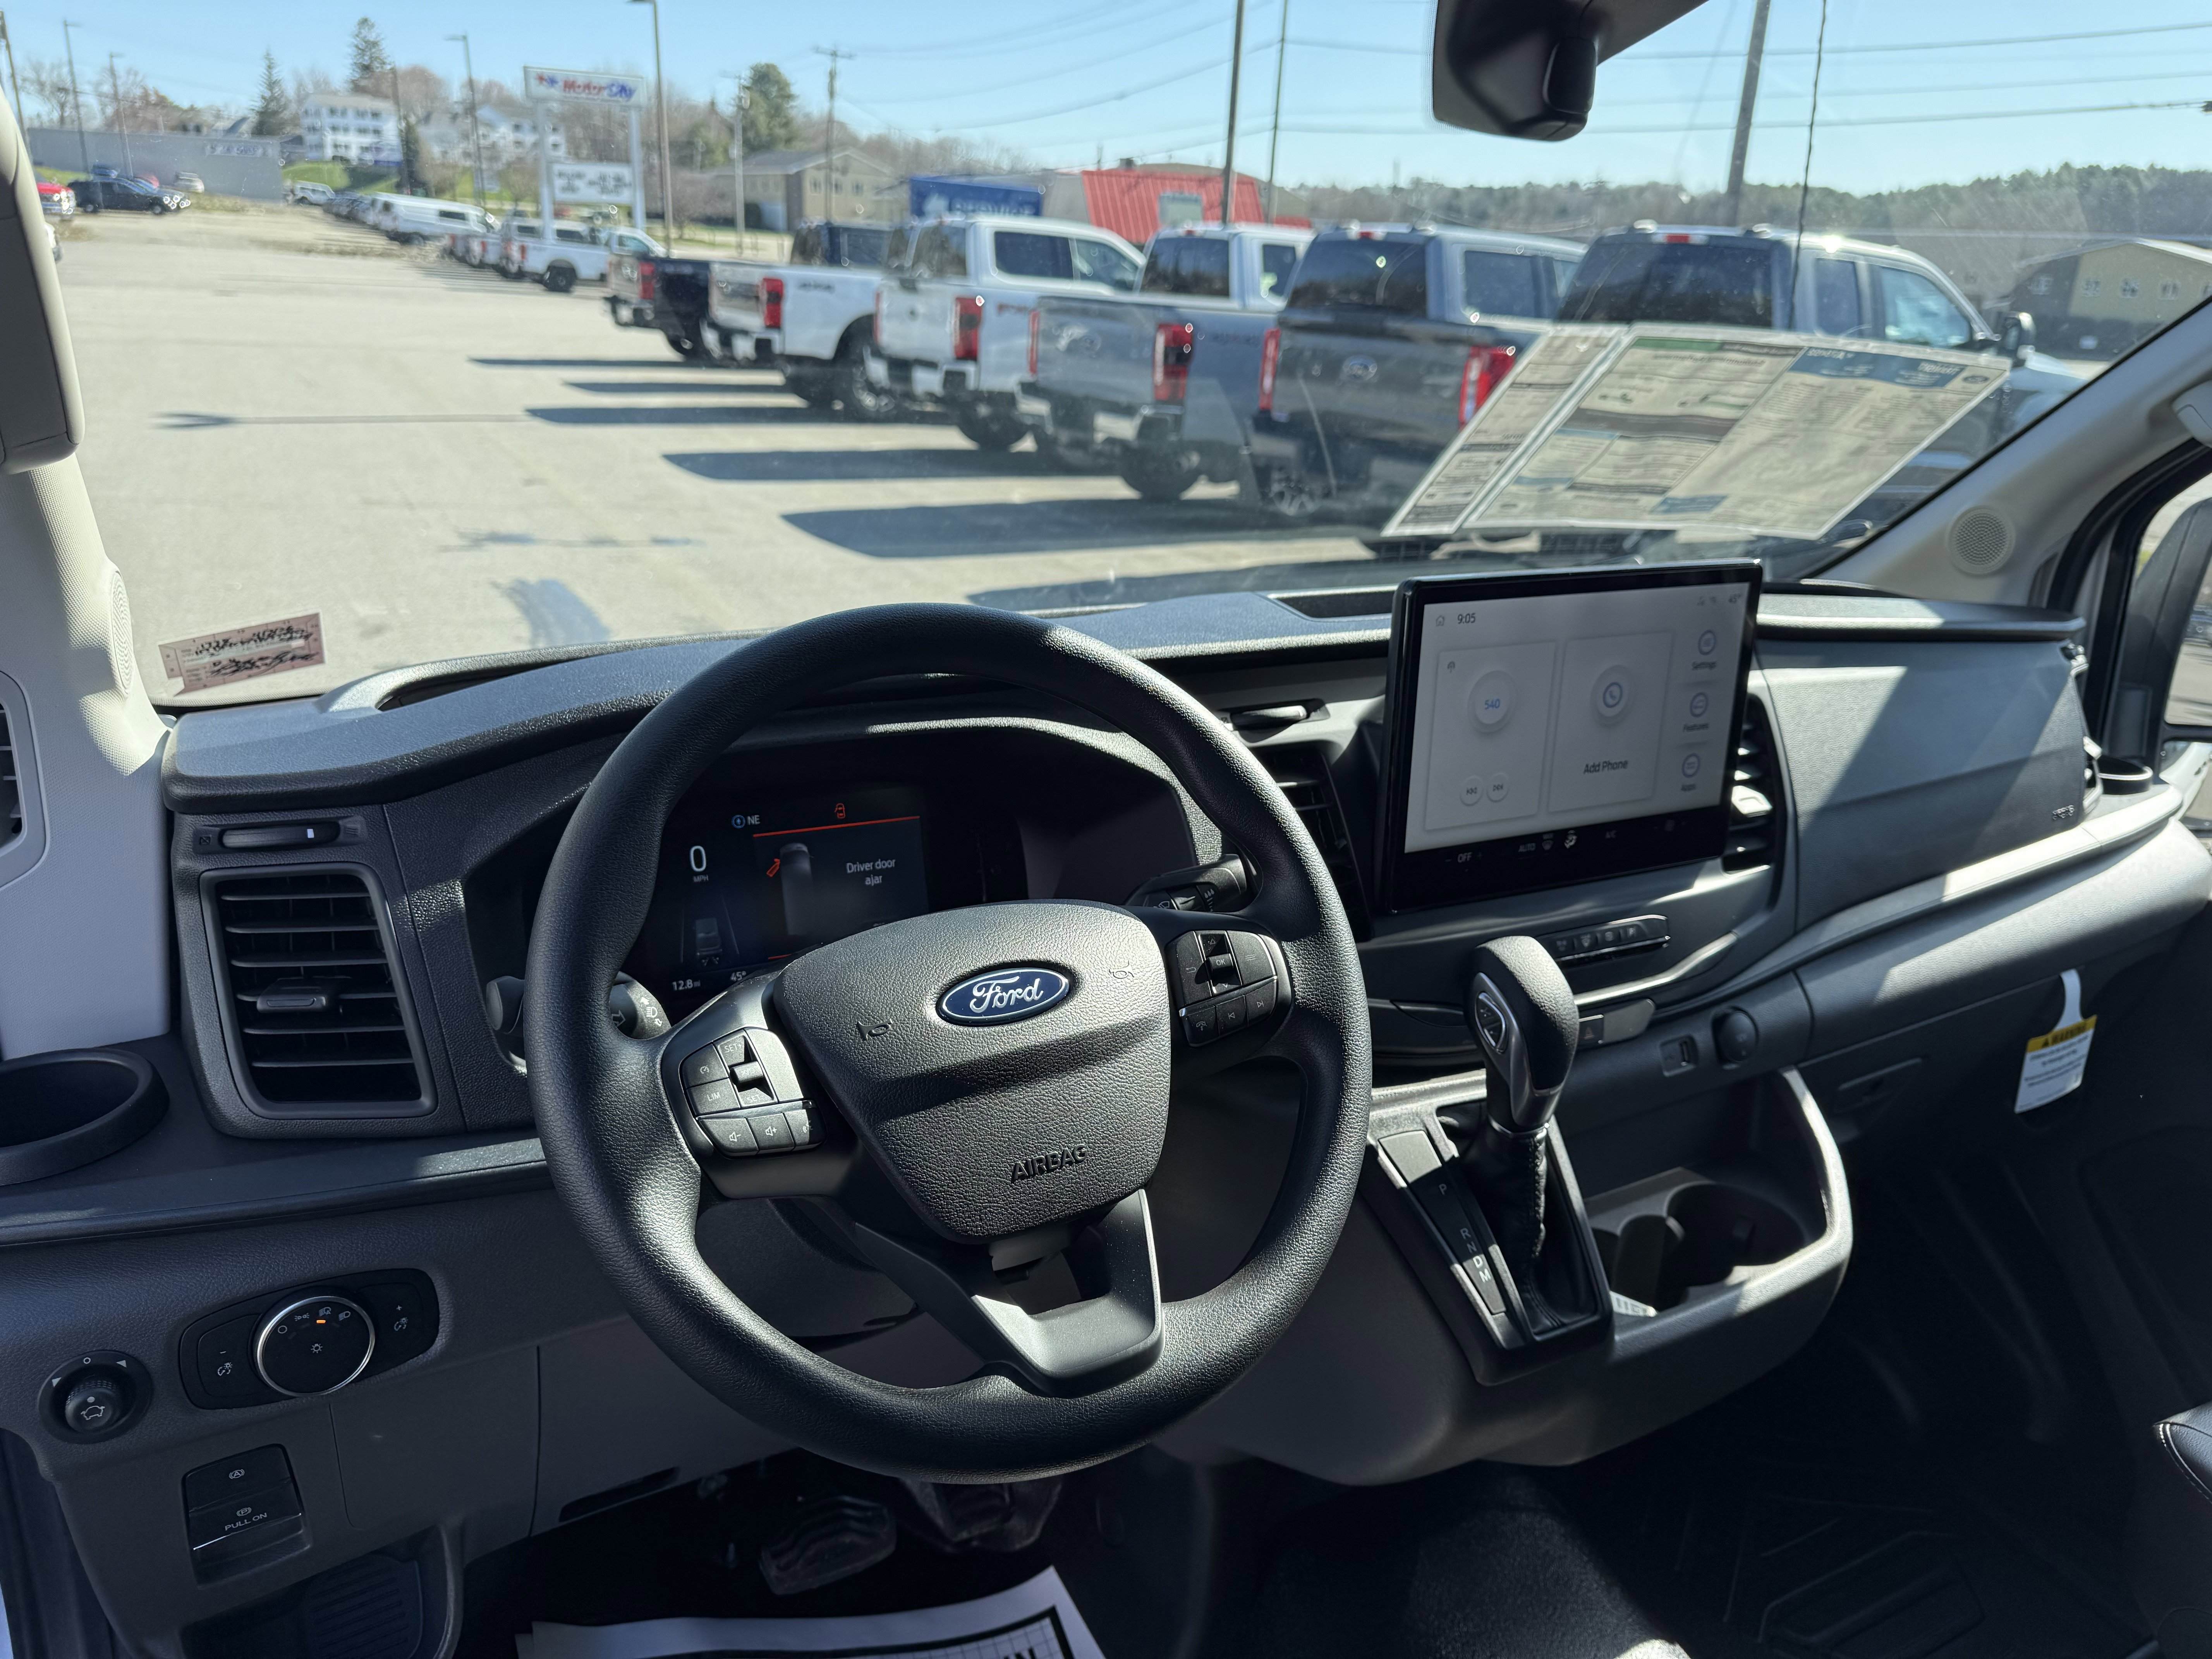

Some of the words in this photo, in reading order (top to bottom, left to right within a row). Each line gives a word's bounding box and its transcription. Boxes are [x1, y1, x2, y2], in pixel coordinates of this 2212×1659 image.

[1457, 613, 1476, 624] 9:05
[1484, 699, 1501, 710] 540
[1583, 762, 1601, 774] Add
[1602, 760, 1628, 771] Phone
[747, 815, 761, 825] NE
[690, 845, 706, 872] 0
[1457, 852, 1473, 863] OFF
[846, 862, 873, 874] Driver
[875, 859, 896, 870] door
[693, 874, 708, 883] MPH
[865, 874, 882, 886] ajar
[672, 979, 693, 991] 12.8
[970, 976, 1044, 1013] Ford
[708, 1092, 721, 1101] LIM
[1012, 1144, 1089, 1181] AIRBAG
[1439, 1183, 1447, 1195] P
[1460, 1228, 1471, 1239] R
[1467, 1241, 1477, 1254] N
[1473, 1255, 1483, 1269] D
[1479, 1269, 1491, 1283] M
[225, 1519, 251, 1531] PULL
[252, 1513, 267, 1521] ON
